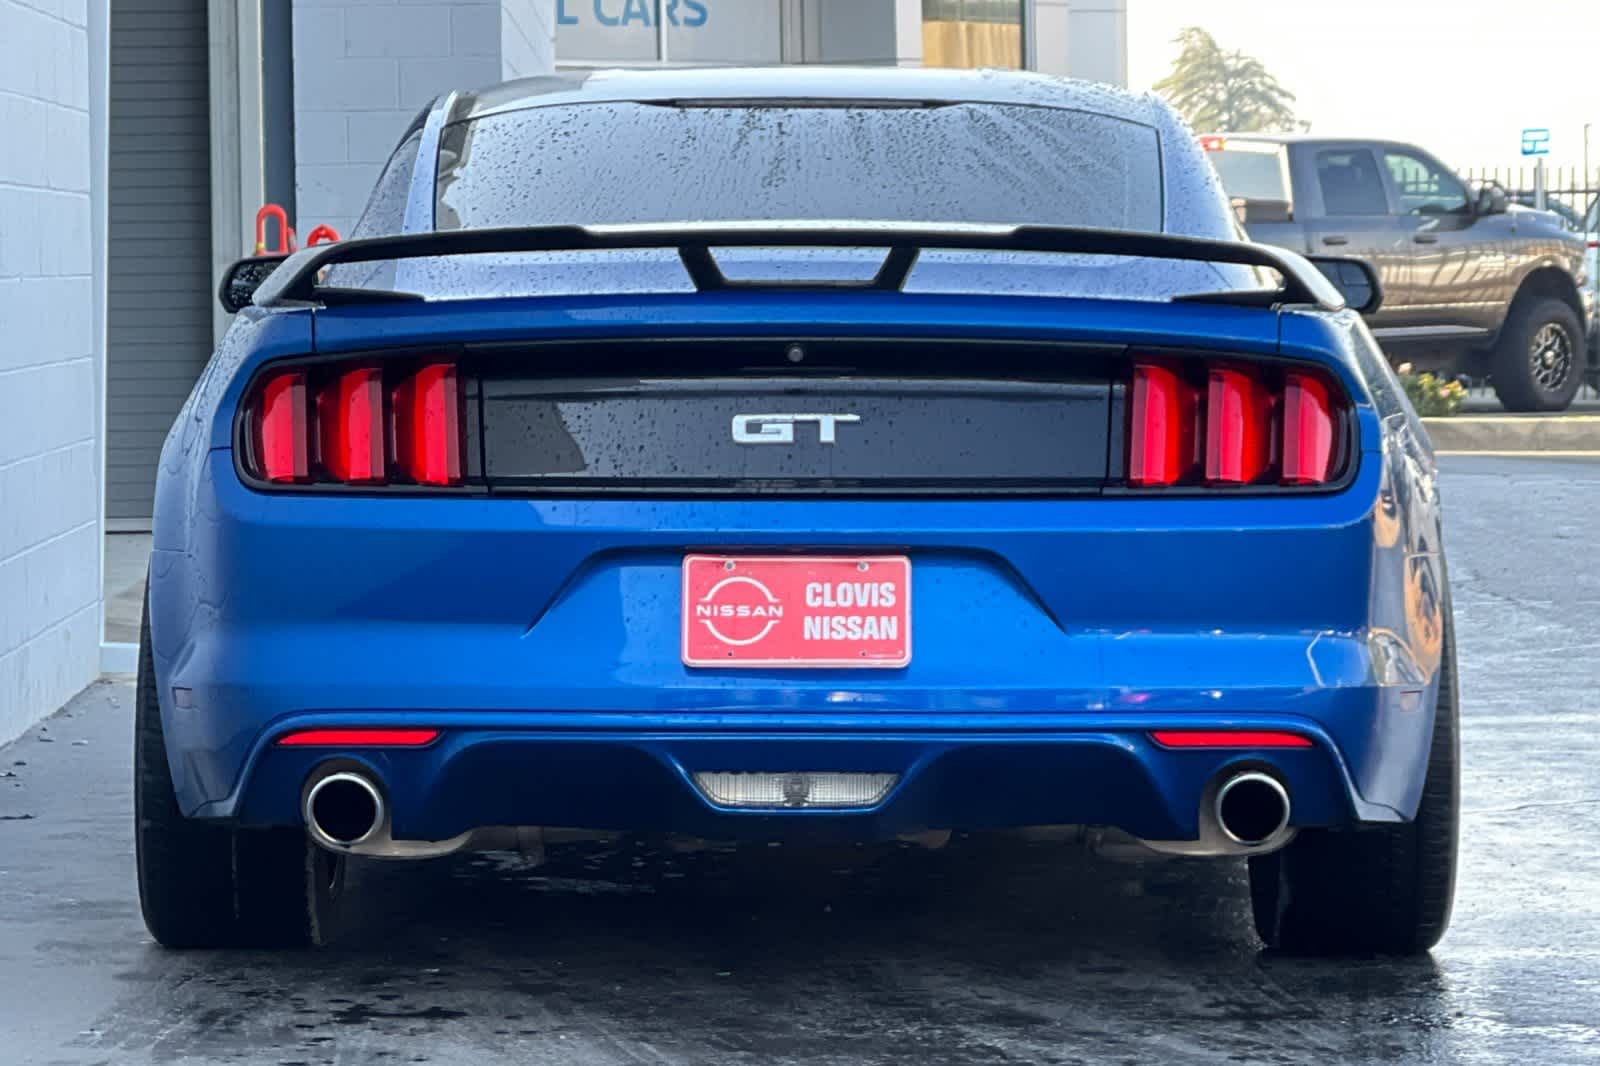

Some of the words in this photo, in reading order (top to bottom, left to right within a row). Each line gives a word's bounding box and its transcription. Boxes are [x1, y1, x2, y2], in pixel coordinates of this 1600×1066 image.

[732, 413, 861, 444] GT
[805, 582, 896, 608] CLOVIS
[696, 604, 784, 617] NISSAN
[803, 615, 898, 640] NISSAN
